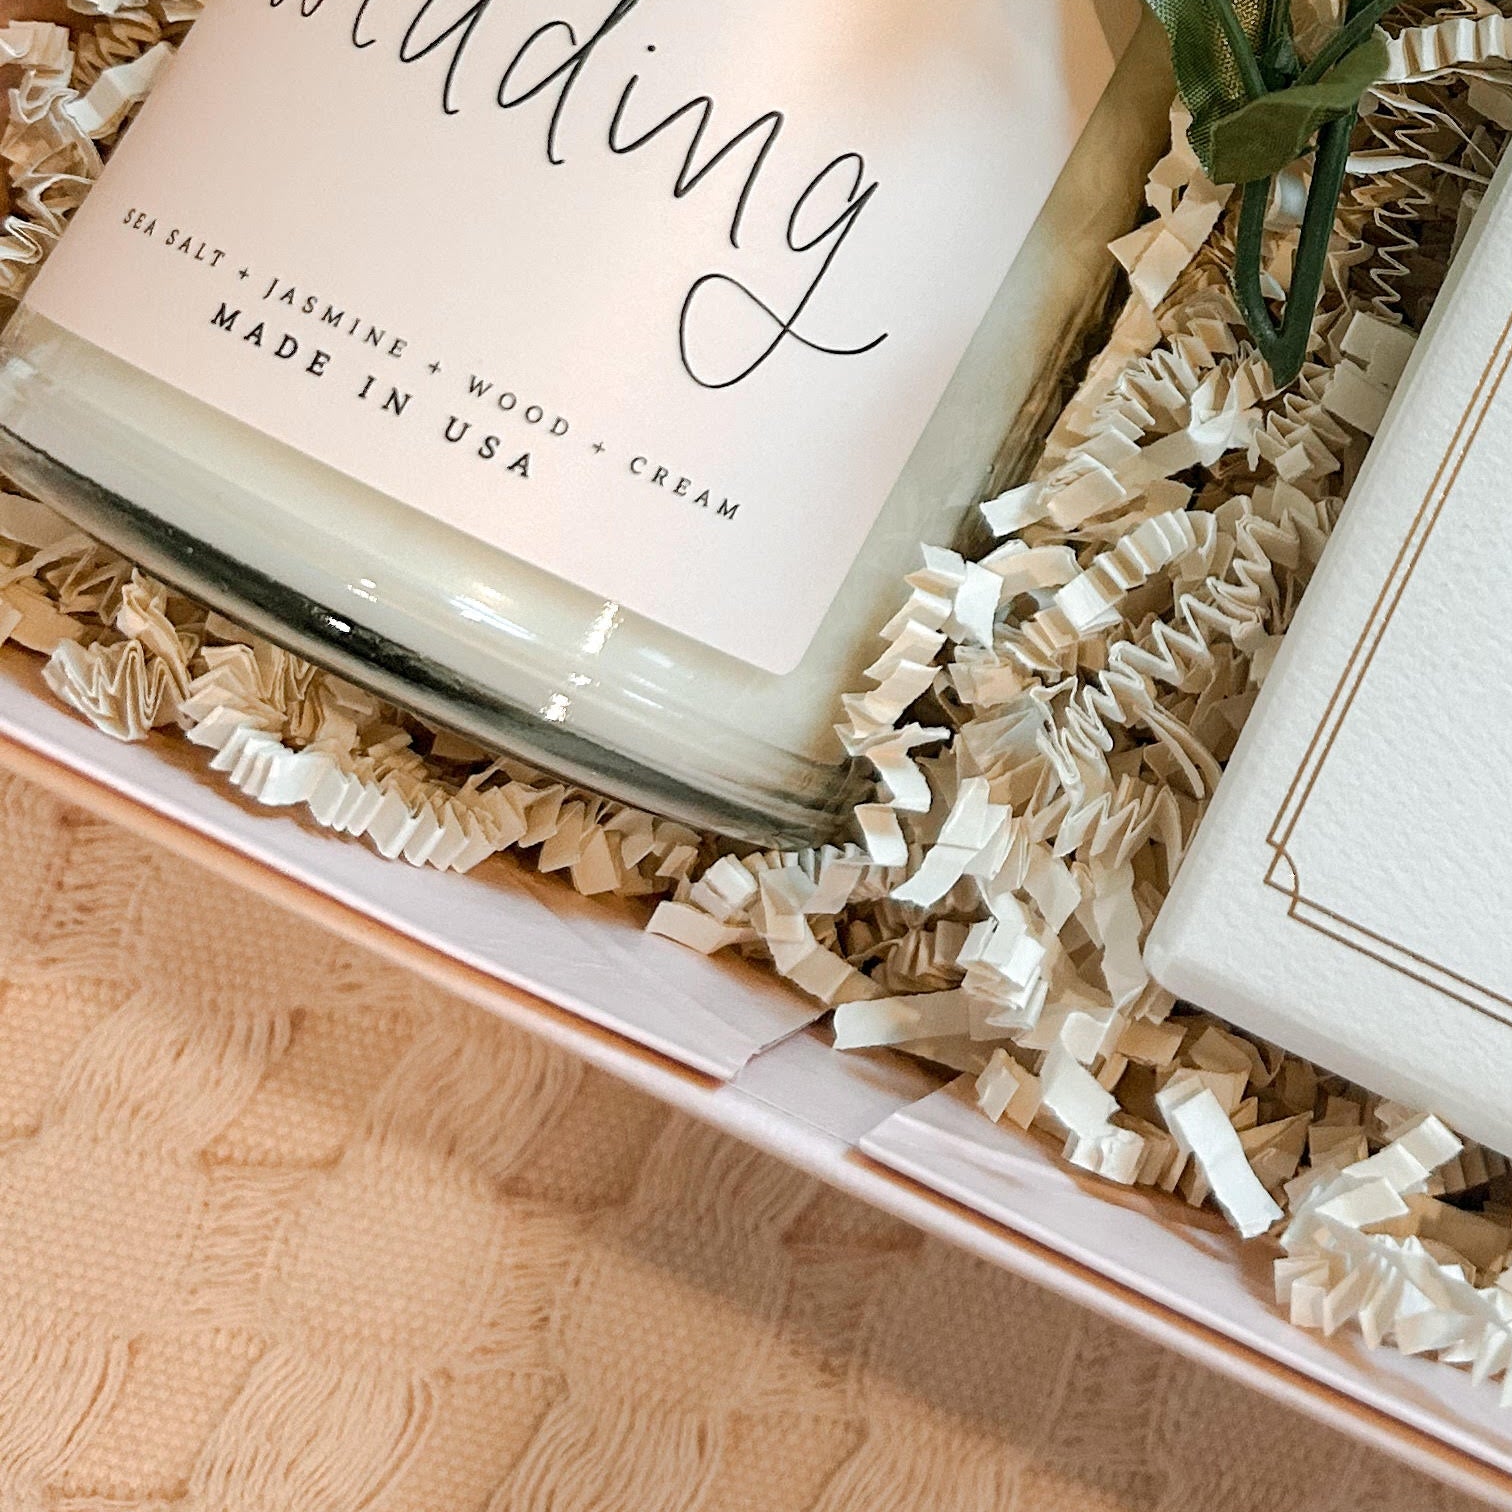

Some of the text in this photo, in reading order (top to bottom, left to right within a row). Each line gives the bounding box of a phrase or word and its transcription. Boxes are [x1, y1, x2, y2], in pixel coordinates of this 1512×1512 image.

[122, 207, 157, 237] SEA
[164, 228, 226, 268] SALT
[261, 277, 409, 360] JASMINE
[467, 374, 572, 438] WOOD
[630, 454, 742, 521] CREAM
[209, 301, 537, 479] MADE IN USA
